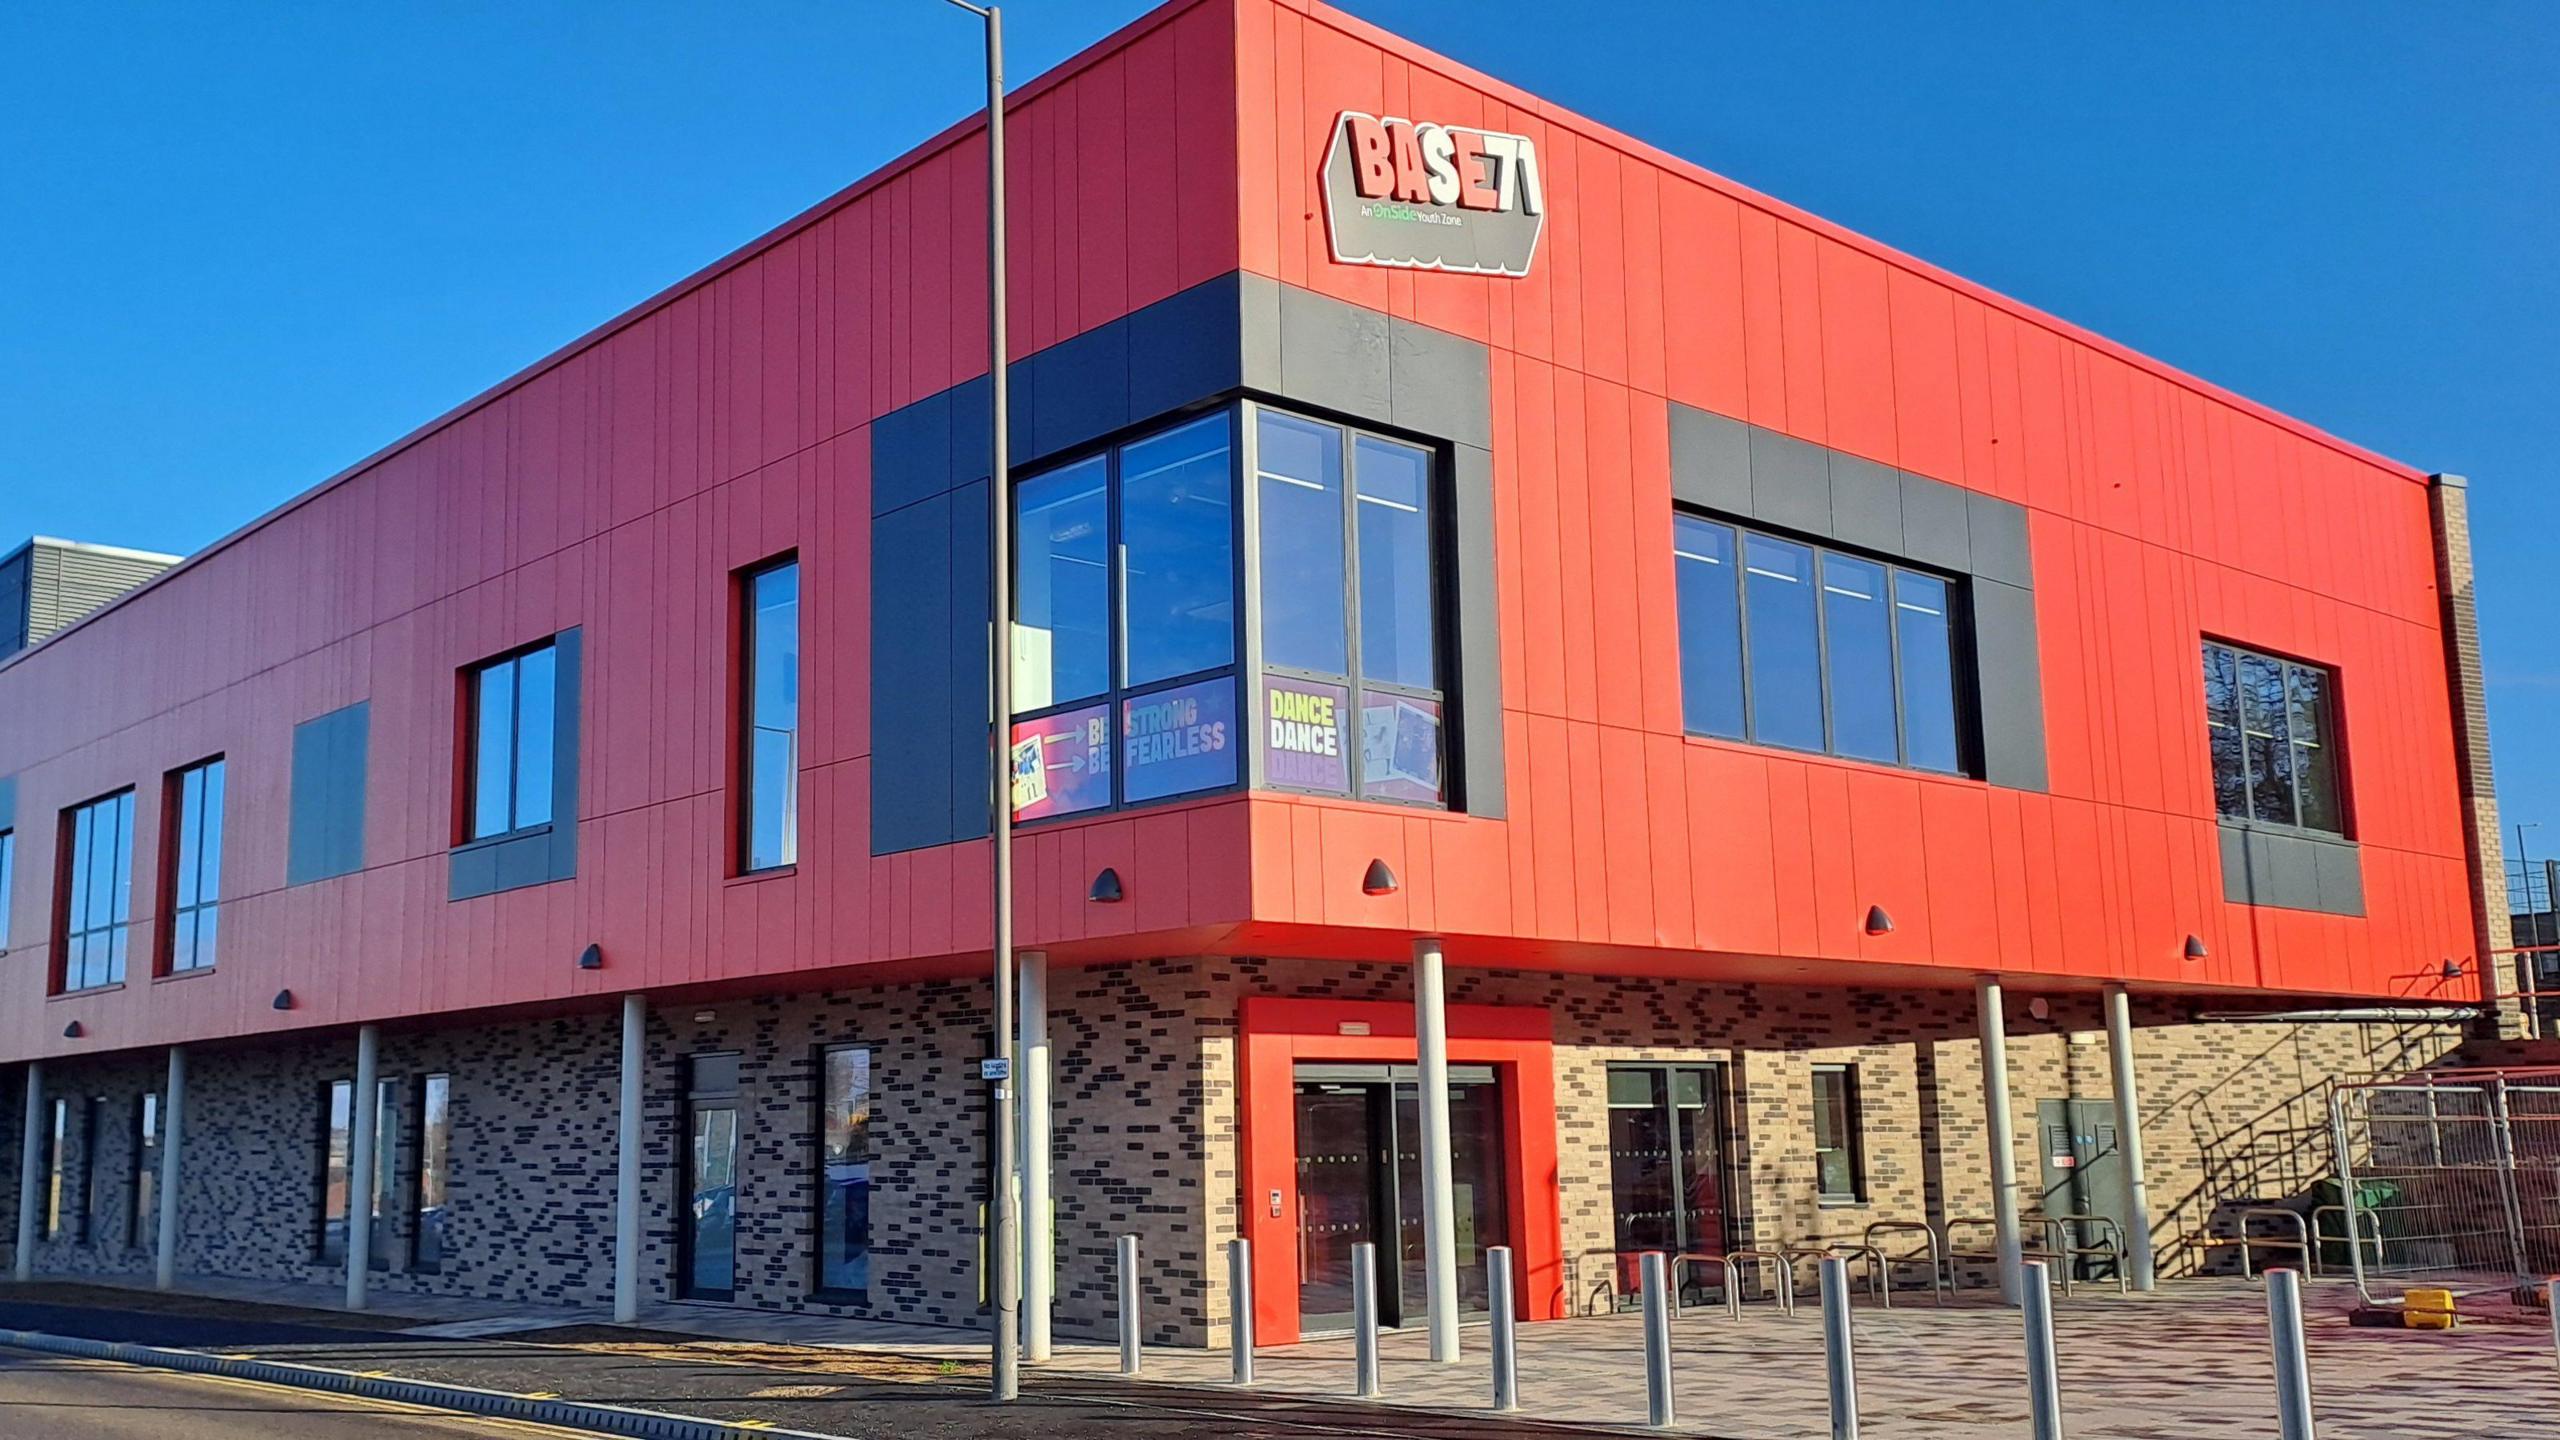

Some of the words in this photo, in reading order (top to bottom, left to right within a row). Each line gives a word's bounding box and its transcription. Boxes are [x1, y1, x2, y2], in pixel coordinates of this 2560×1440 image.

[1350, 117, 1542, 214] BASE71
[1361, 204, 1373, 217] An
[1373, 202, 1418, 221] OnSide
[1417, 210, 1441, 225] Youth
[1441, 213, 1462, 226] Zone
[1129, 698, 1198, 738] STRONG
[1270, 689, 1334, 726] DANCE
[1088, 743, 1109, 775] BE
[1126, 721, 1226, 769] FEARLESS
[1270, 719, 1337, 756] DANCE
[1272, 751, 1338, 785] DANCE
